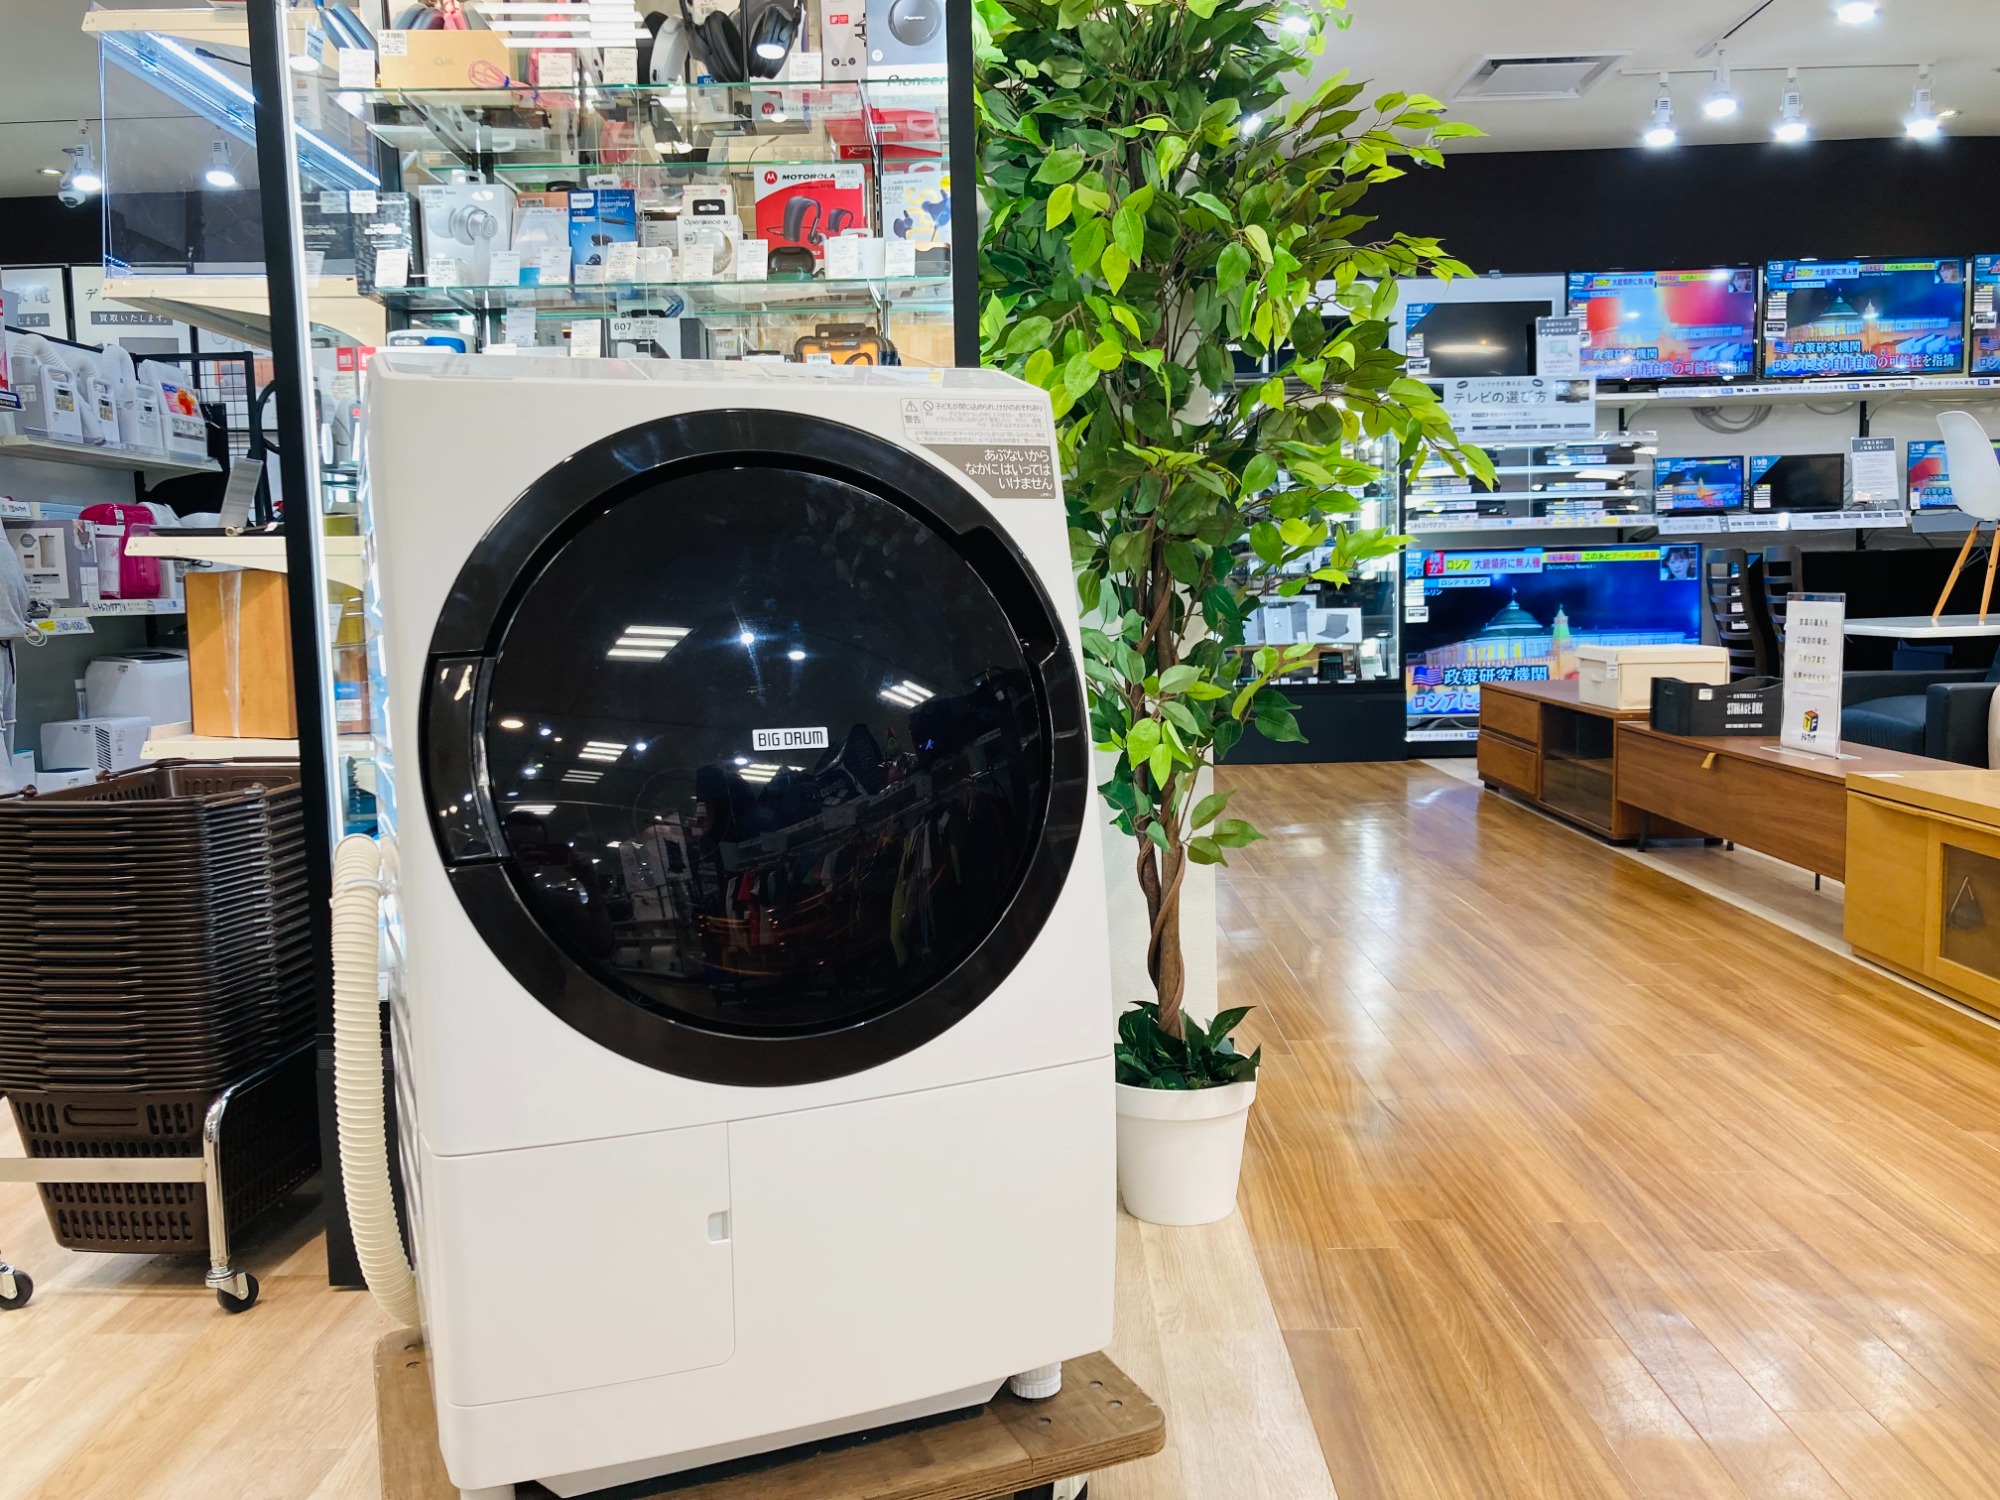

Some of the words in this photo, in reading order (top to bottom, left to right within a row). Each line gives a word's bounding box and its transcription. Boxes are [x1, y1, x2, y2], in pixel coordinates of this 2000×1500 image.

[99, 313, 168, 325] 買取いたします。
[614, 322, 632, 331] 607
[1793, 340, 1862, 354] 政策研究機関
[1772, 352, 1955, 372] ロシアによる自作自演の可能性を指摘
[1454, 389, 1547, 404] テレビの選び方
[984, 449, 1050, 463] あぶないから
[965, 462, 1052, 476] なかにはいっては
[999, 477, 1053, 491] いけません
[1446, 559, 1471, 571] ロシア
[1474, 557, 1541, 570] 大統領府に無人機
[1444, 666, 1548, 685] 政策研究機関
[1726, 702, 1751, 715] STORAGE
[758, 732, 780, 747] BIG
[784, 730, 824, 746] DRUM
